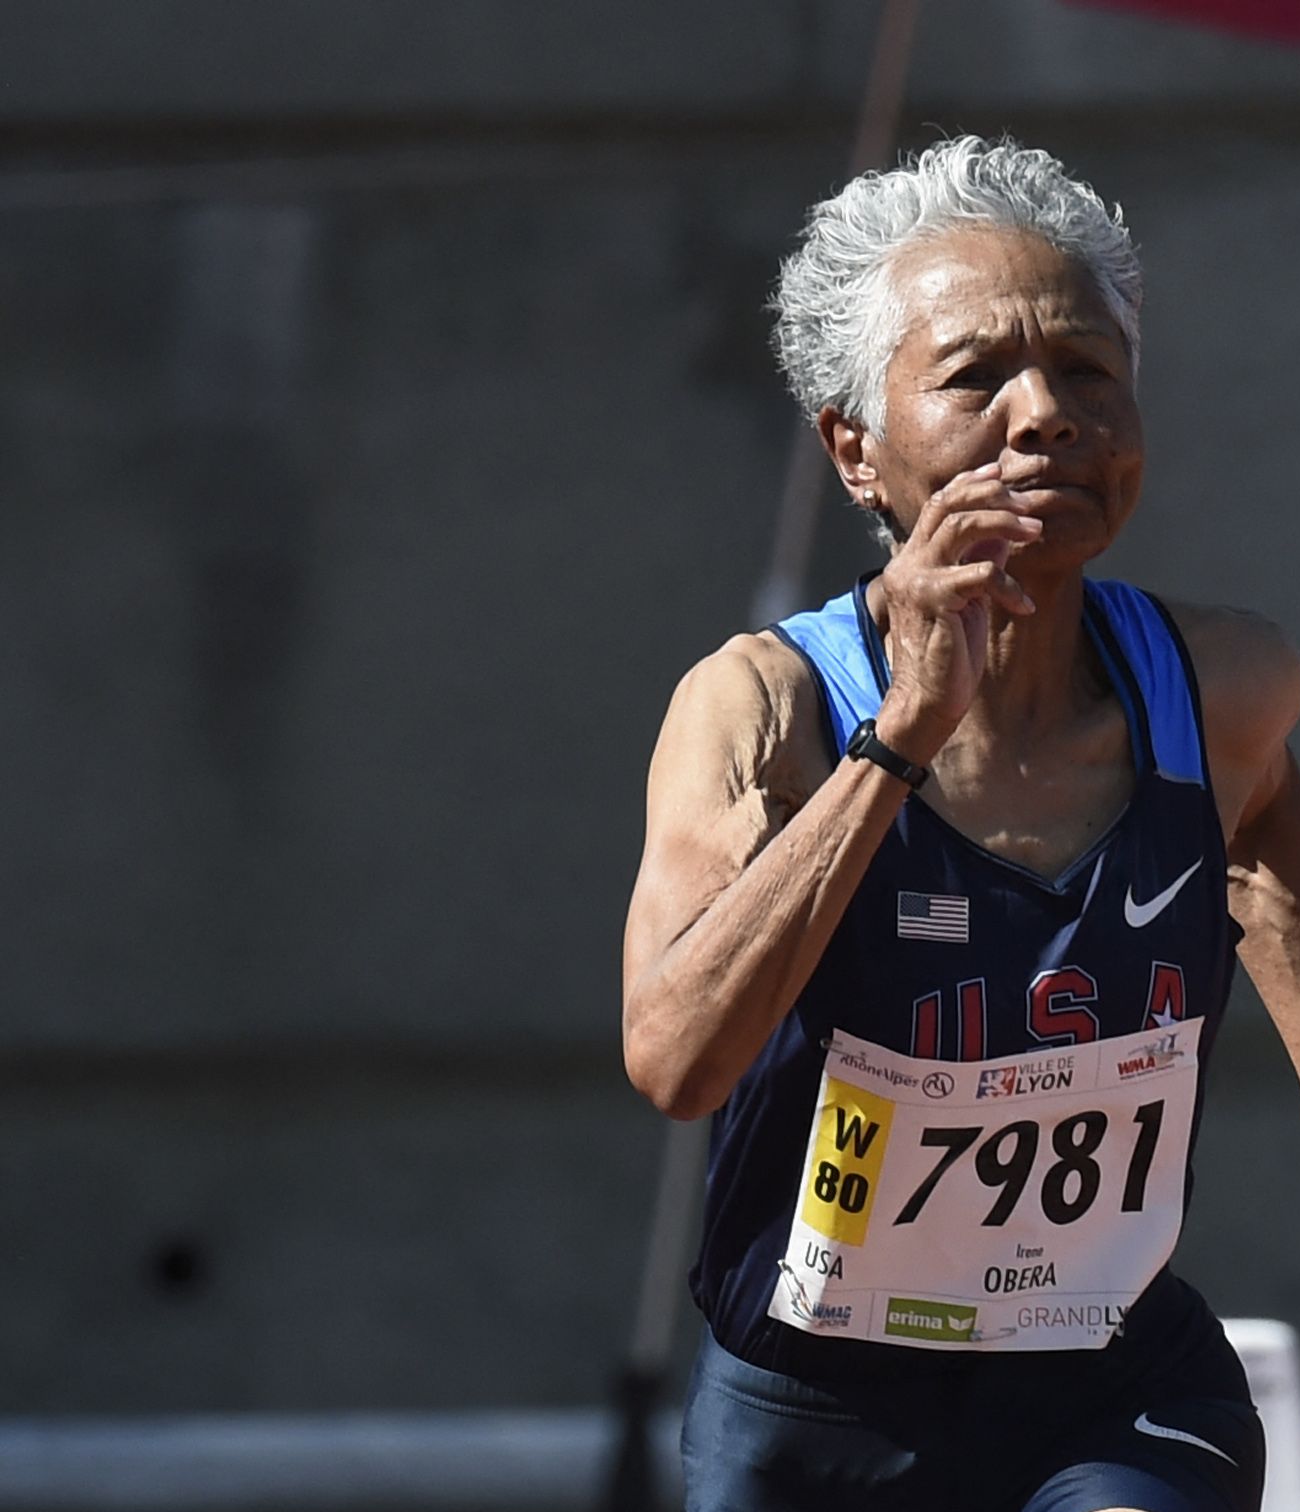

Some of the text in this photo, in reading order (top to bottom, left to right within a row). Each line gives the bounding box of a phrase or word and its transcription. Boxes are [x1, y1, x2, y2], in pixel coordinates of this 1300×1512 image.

[1014, 1069, 1074, 1096] LYON
[1018, 1055, 1075, 1076] VILLE DE
[835, 1106, 881, 1160] W
[892, 1098, 1166, 1228] 7981
[813, 1160, 869, 1214] 80
[804, 1240, 844, 1281] USA
[983, 1262, 1058, 1294] OBERA
[887, 1310, 943, 1331] erima
